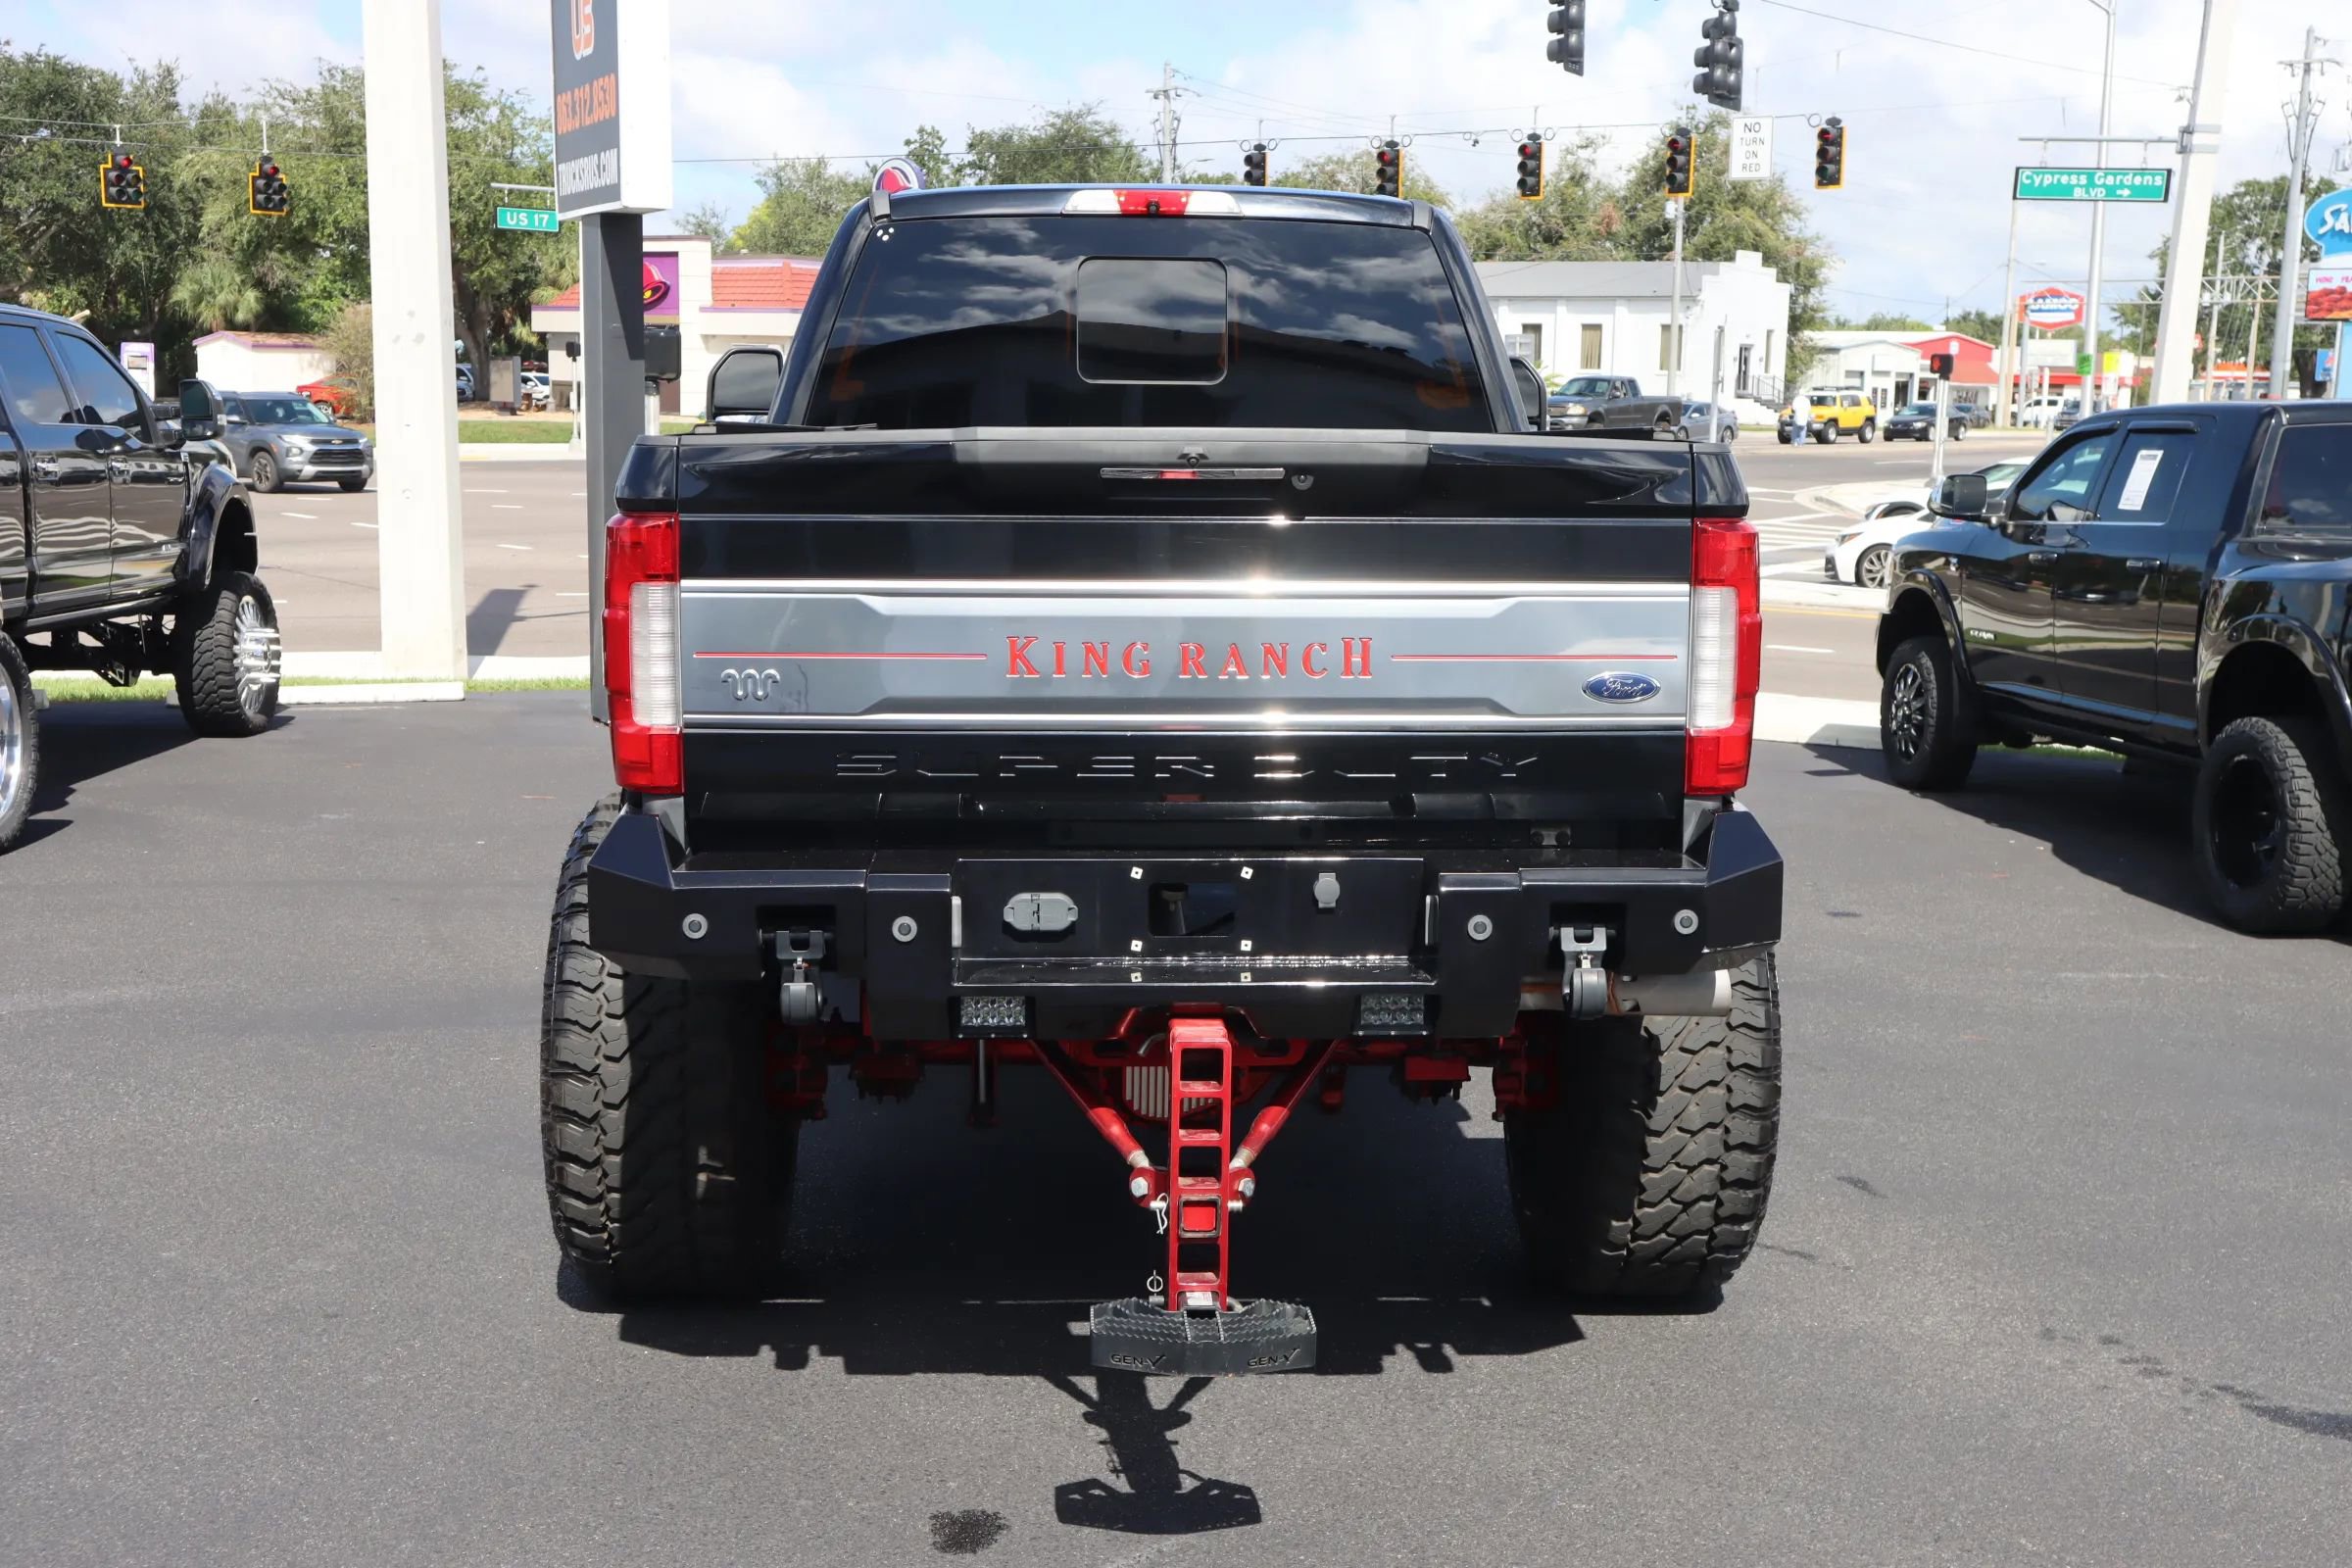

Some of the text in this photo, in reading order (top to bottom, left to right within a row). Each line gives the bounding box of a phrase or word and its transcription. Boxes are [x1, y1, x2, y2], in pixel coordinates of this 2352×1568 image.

[1743, 122, 1761, 133] NO
[1740, 136, 1764, 146] TURN
[1744, 150, 1758, 160] ON
[558, 148, 618, 196] TRUCKSRUS.COM
[1741, 163, 1761, 172] RED
[2021, 171, 2163, 187] Cypress Gardens
[2073, 187, 2106, 198] BLVD
[507, 211, 549, 227] US 17
[2318, 203, 2352, 235] SA
[1005, 636, 1373, 679] KING RANCH
[836, 754, 1539, 778] SUPER DUTY
[1110, 1353, 1166, 1368] GEN-Y
